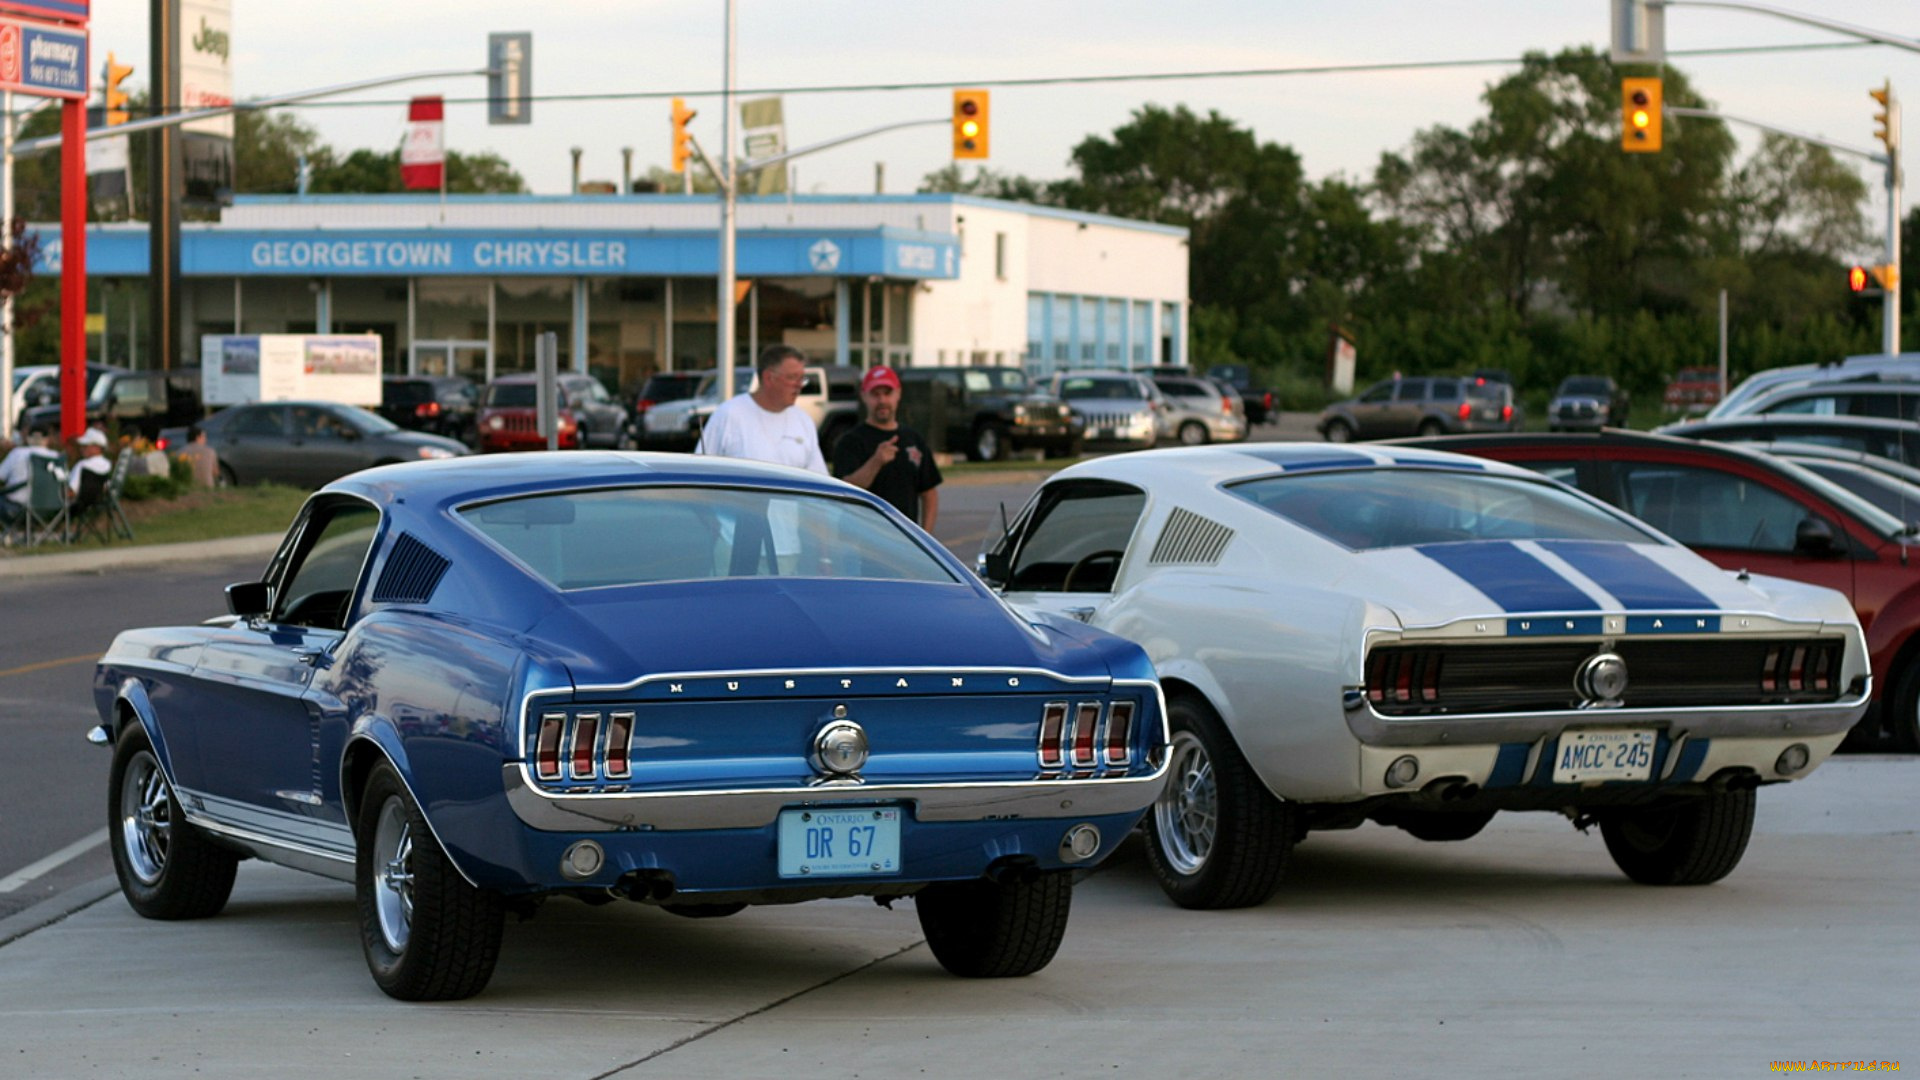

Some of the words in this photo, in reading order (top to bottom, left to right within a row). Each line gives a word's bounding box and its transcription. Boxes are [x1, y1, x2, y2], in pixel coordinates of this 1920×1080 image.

[30, 33, 79, 69] pharmacy
[193, 16, 229, 65] Jeep
[251, 241, 451, 267] GEORGETOWN
[473, 241, 626, 267] CHRYSLER
[1475, 619, 1750, 632] MUSTANG
[670, 677, 1020, 694] MUSTANG
[1560, 743, 1607, 770] AMCC
[1614, 742, 1650, 769] 245
[806, 827, 834, 859] DR
[848, 825, 876, 857] 67
